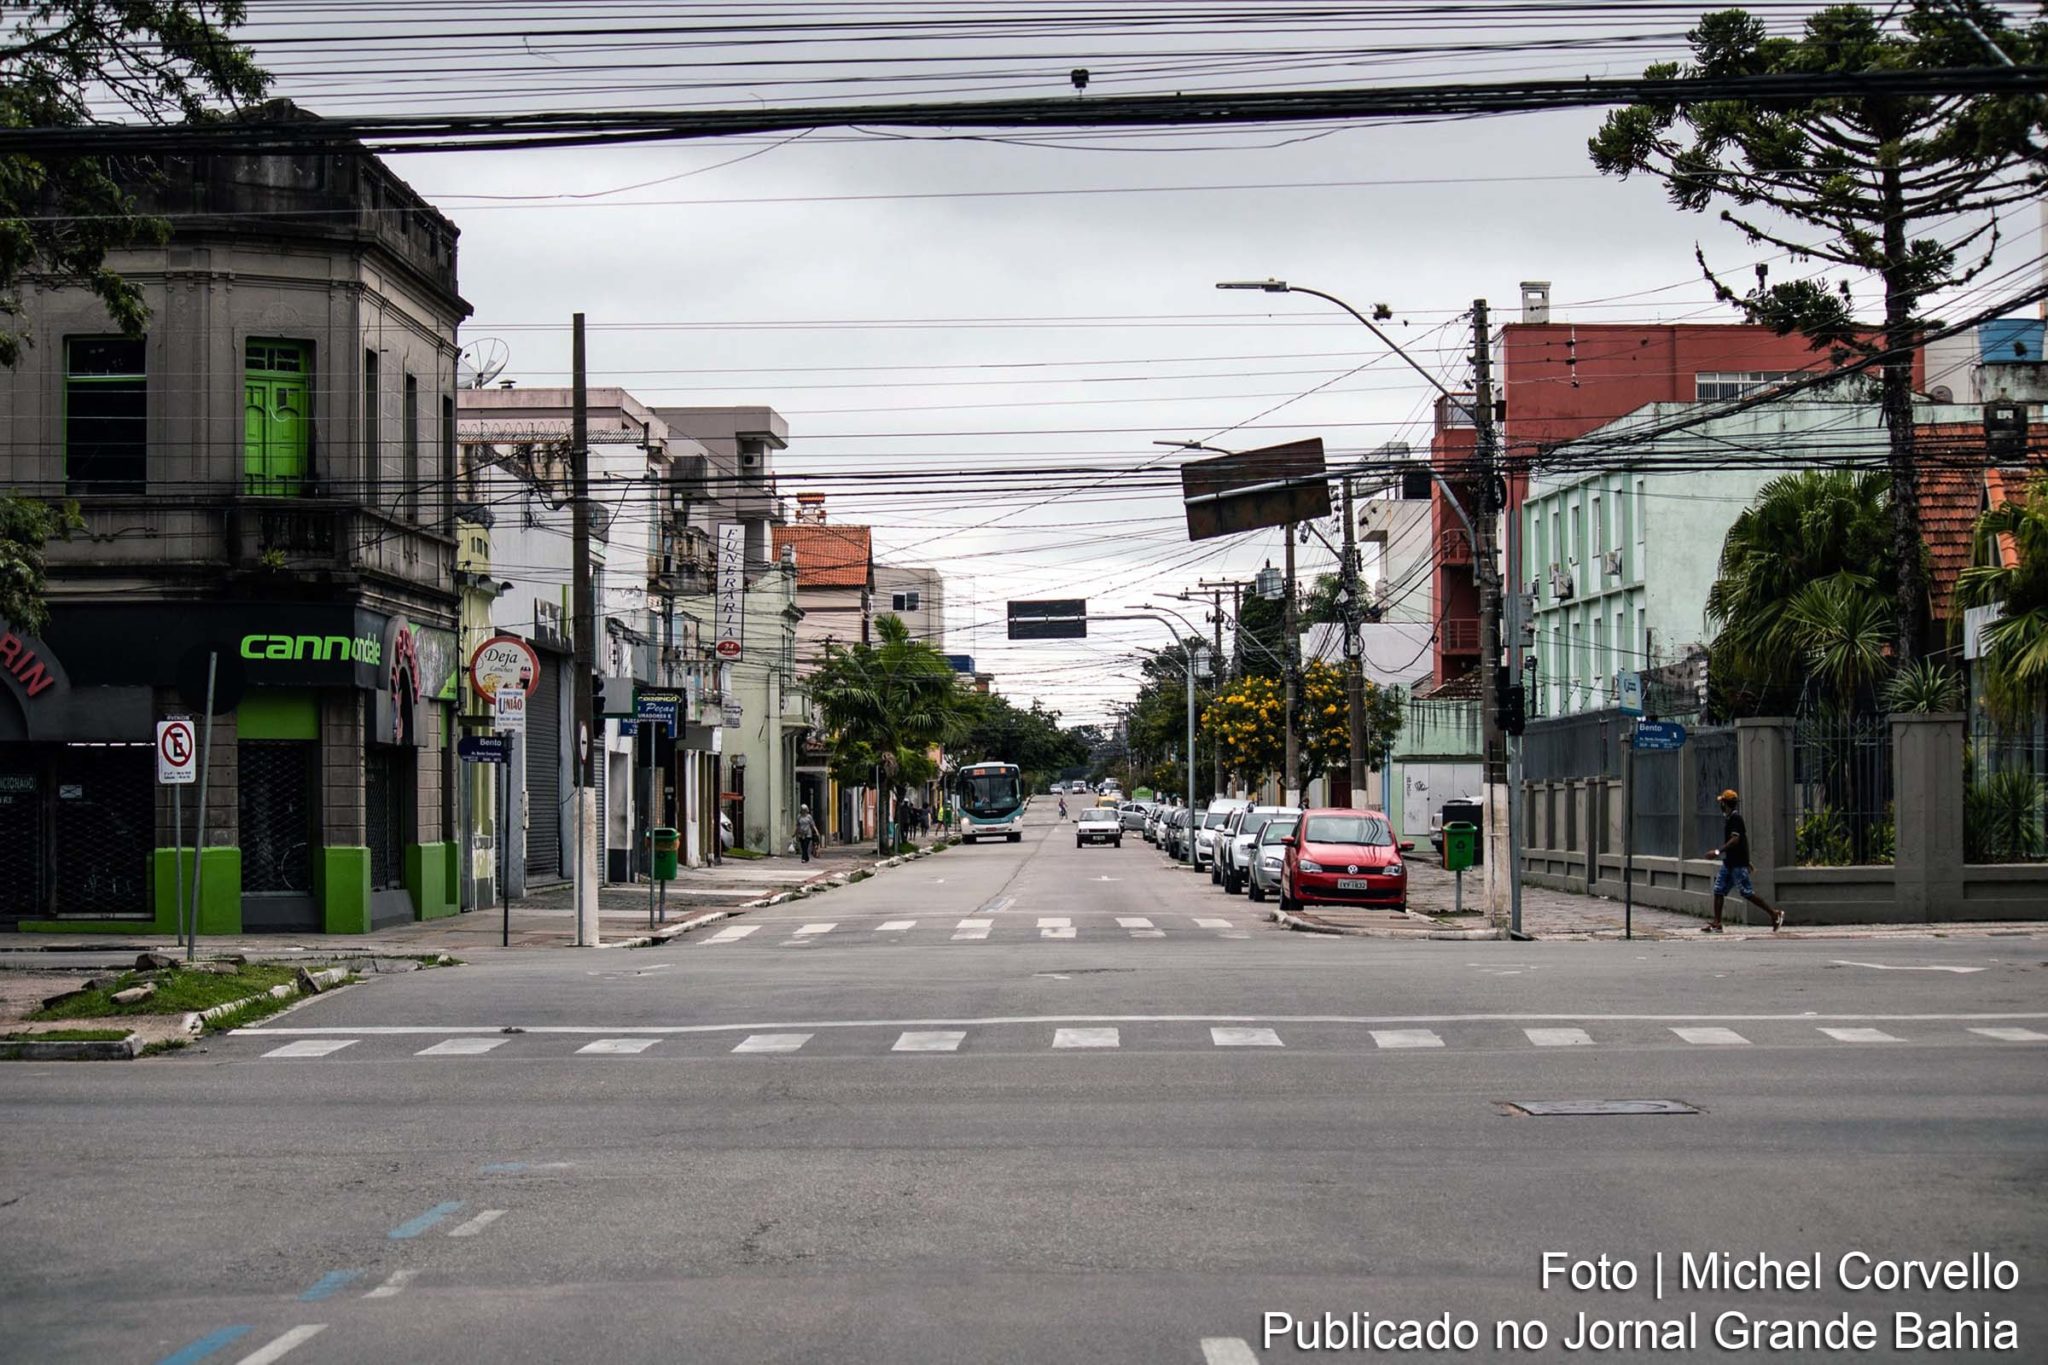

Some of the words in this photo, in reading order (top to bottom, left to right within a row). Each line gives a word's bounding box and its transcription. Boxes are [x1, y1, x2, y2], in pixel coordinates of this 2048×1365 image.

[240, 633, 381, 666] cannondale
[485, 648, 518, 667] Deja
[499, 696, 523, 714] UNIÃO
[645, 702, 674, 713] Peças
[1640, 723, 1662, 733] Bento
[480, 738, 502, 746] Bento
